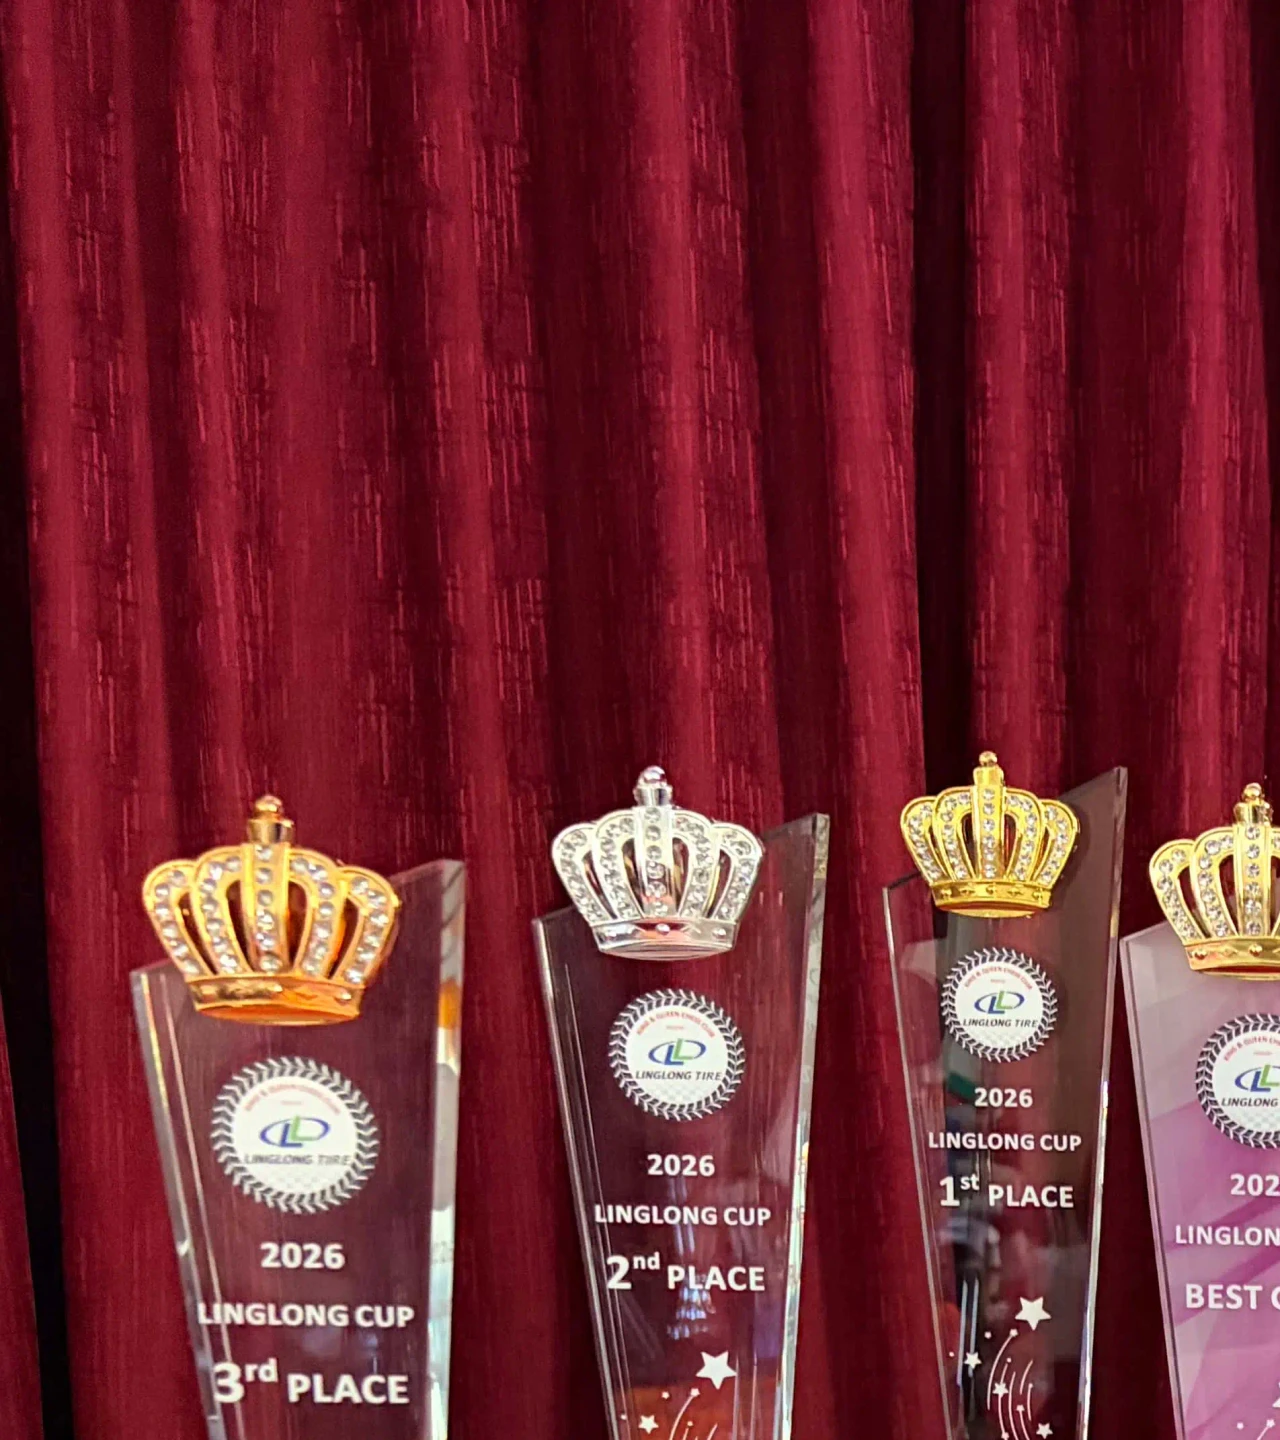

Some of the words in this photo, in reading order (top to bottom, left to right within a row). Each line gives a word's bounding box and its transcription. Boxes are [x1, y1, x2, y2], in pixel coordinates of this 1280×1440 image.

[963, 1018, 1011, 1027] LINGLONG
[1015, 1019, 1037, 1028] TIRE
[636, 1070, 691, 1080] LINGLONG
[695, 1072, 722, 1081] TIRE
[974, 1088, 1033, 1107] 2026
[1221, 1098, 1278, 1107] LINGLONG
[928, 1132, 1035, 1150] LINGLONG
[1040, 1134, 1082, 1151] CUP
[647, 1154, 715, 1176] 2026
[939, 1174, 979, 1206] 1st
[989, 1185, 1074, 1208] PLACE
[594, 1204, 717, 1225] LINGLONG
[724, 1207, 771, 1226] CUP
[261, 1243, 345, 1269] 2026
[607, 1252, 660, 1289] 2nd
[667, 1265, 765, 1291] PLACE
[1185, 1283, 1263, 1310] BEST
[198, 1303, 348, 1326] LINGLONG
[355, 1305, 415, 1327] CUP
[214, 1358, 278, 1403] 3rd
[287, 1374, 409, 1403] PLACE
